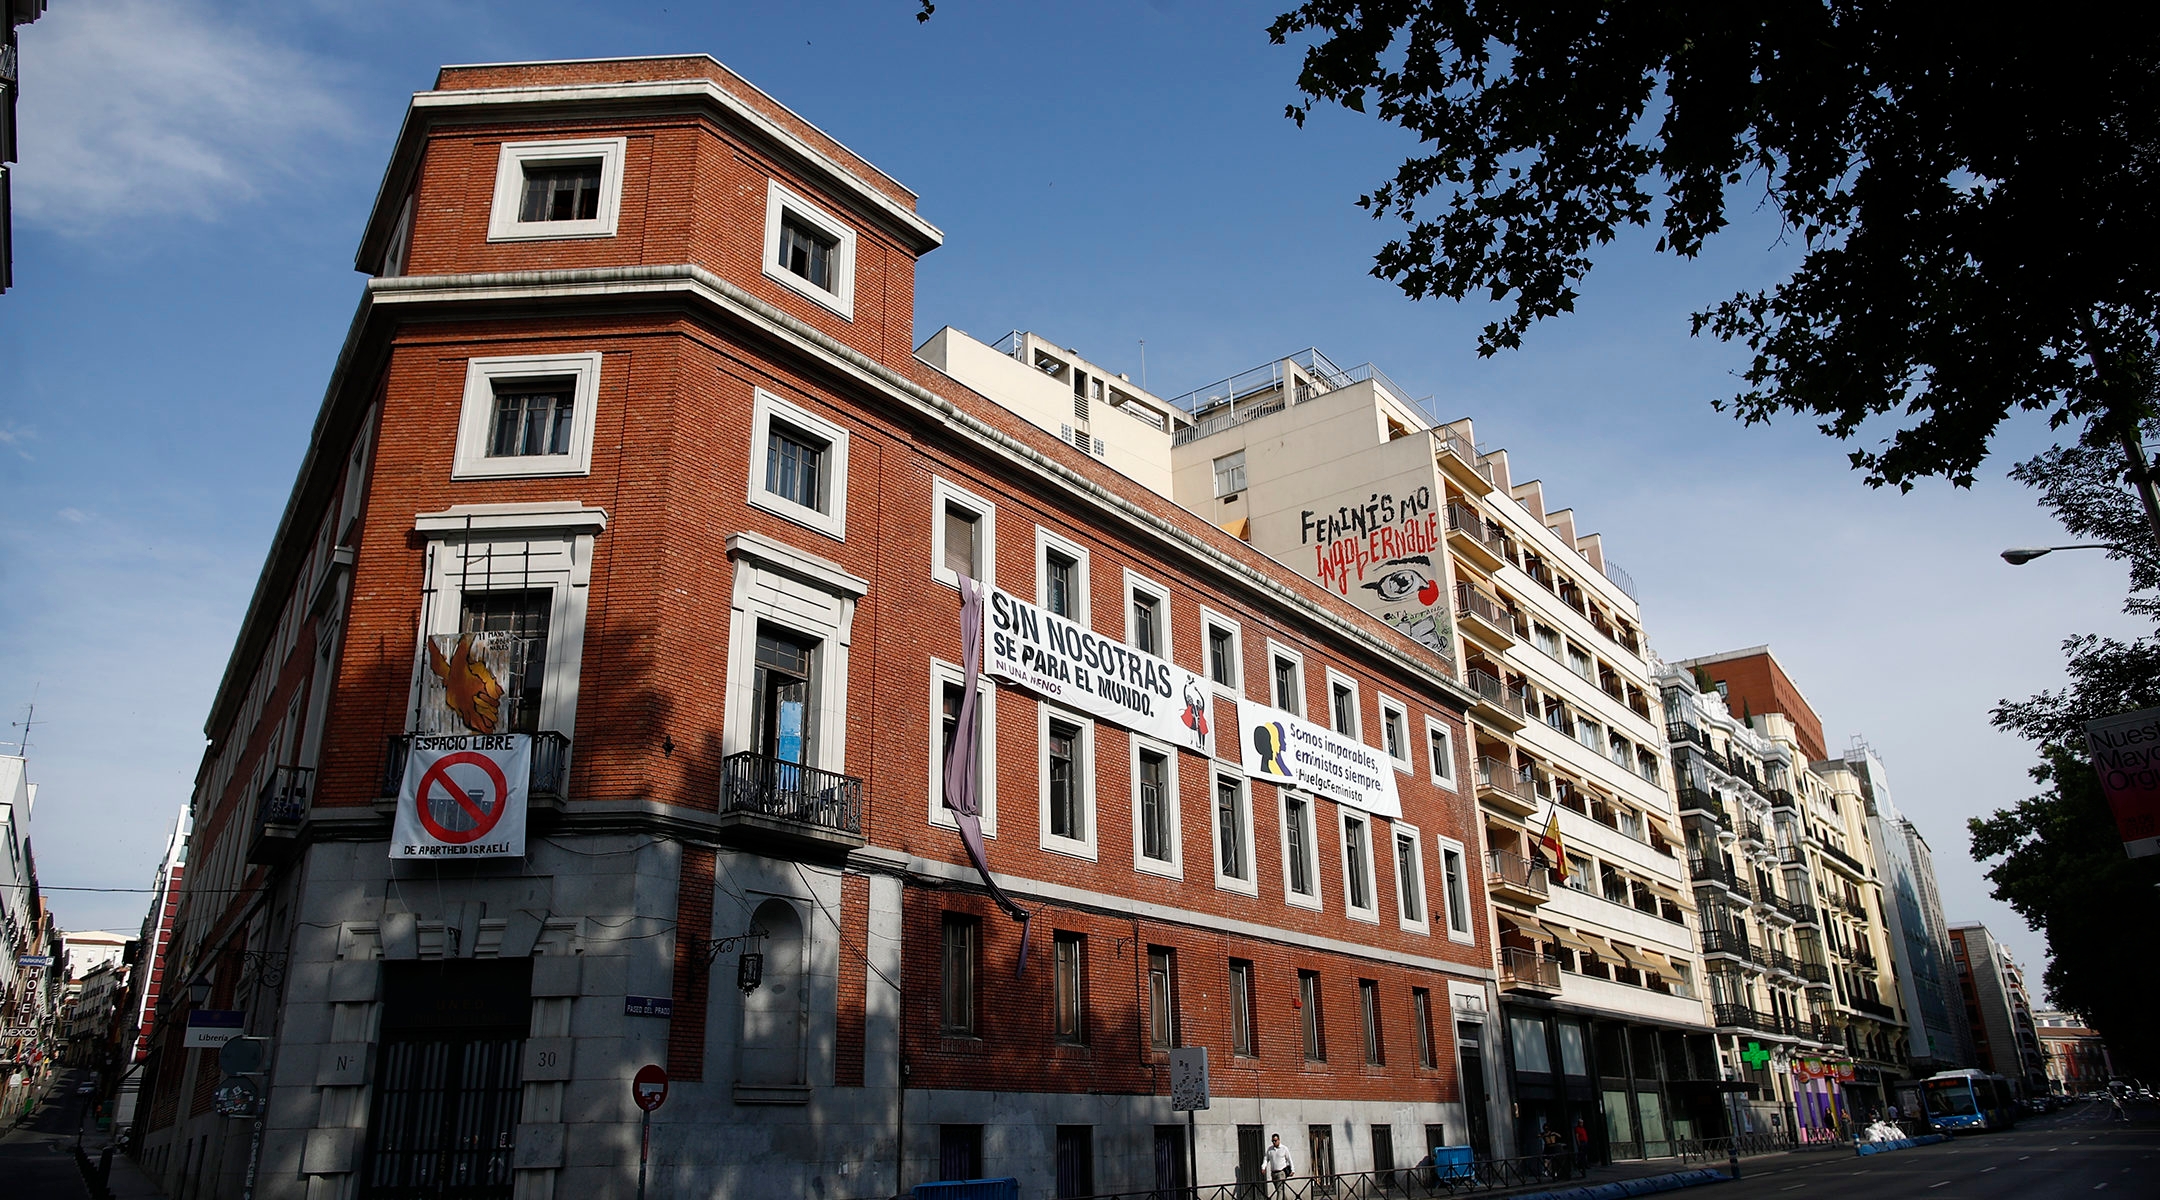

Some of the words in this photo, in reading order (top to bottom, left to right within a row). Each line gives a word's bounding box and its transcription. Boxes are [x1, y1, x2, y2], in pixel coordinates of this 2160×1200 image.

[991, 591, 1041, 644] SIN
[1046, 616, 1172, 699] NOSOTRAS
[993, 631, 1017, 663] SE
[1022, 643, 1071, 684] PARA
[1075, 666, 1094, 694] EL
[1097, 675, 1155, 718] MUNDO.
[996, 659, 1007, 672] NI
[1008, 666, 1028, 682] UNA
[415, 735, 468, 751] ESPACIO
[1290, 723, 1323, 749] Somos
[1324, 735, 1379, 774] imparables,
[1294, 745, 1343, 777] eministas
[1344, 766, 1384, 792] siempre.
[404, 845, 416, 855] DE
[19, 957, 46, 965] PARKING
[19, 968, 39, 1026] HOTEL
[626, 1004, 643, 1014] PASEO
[644, 1006, 653, 1014] DEL
[654, 1006, 671, 1015] PRADO
[537, 1051, 557, 1068] 30
